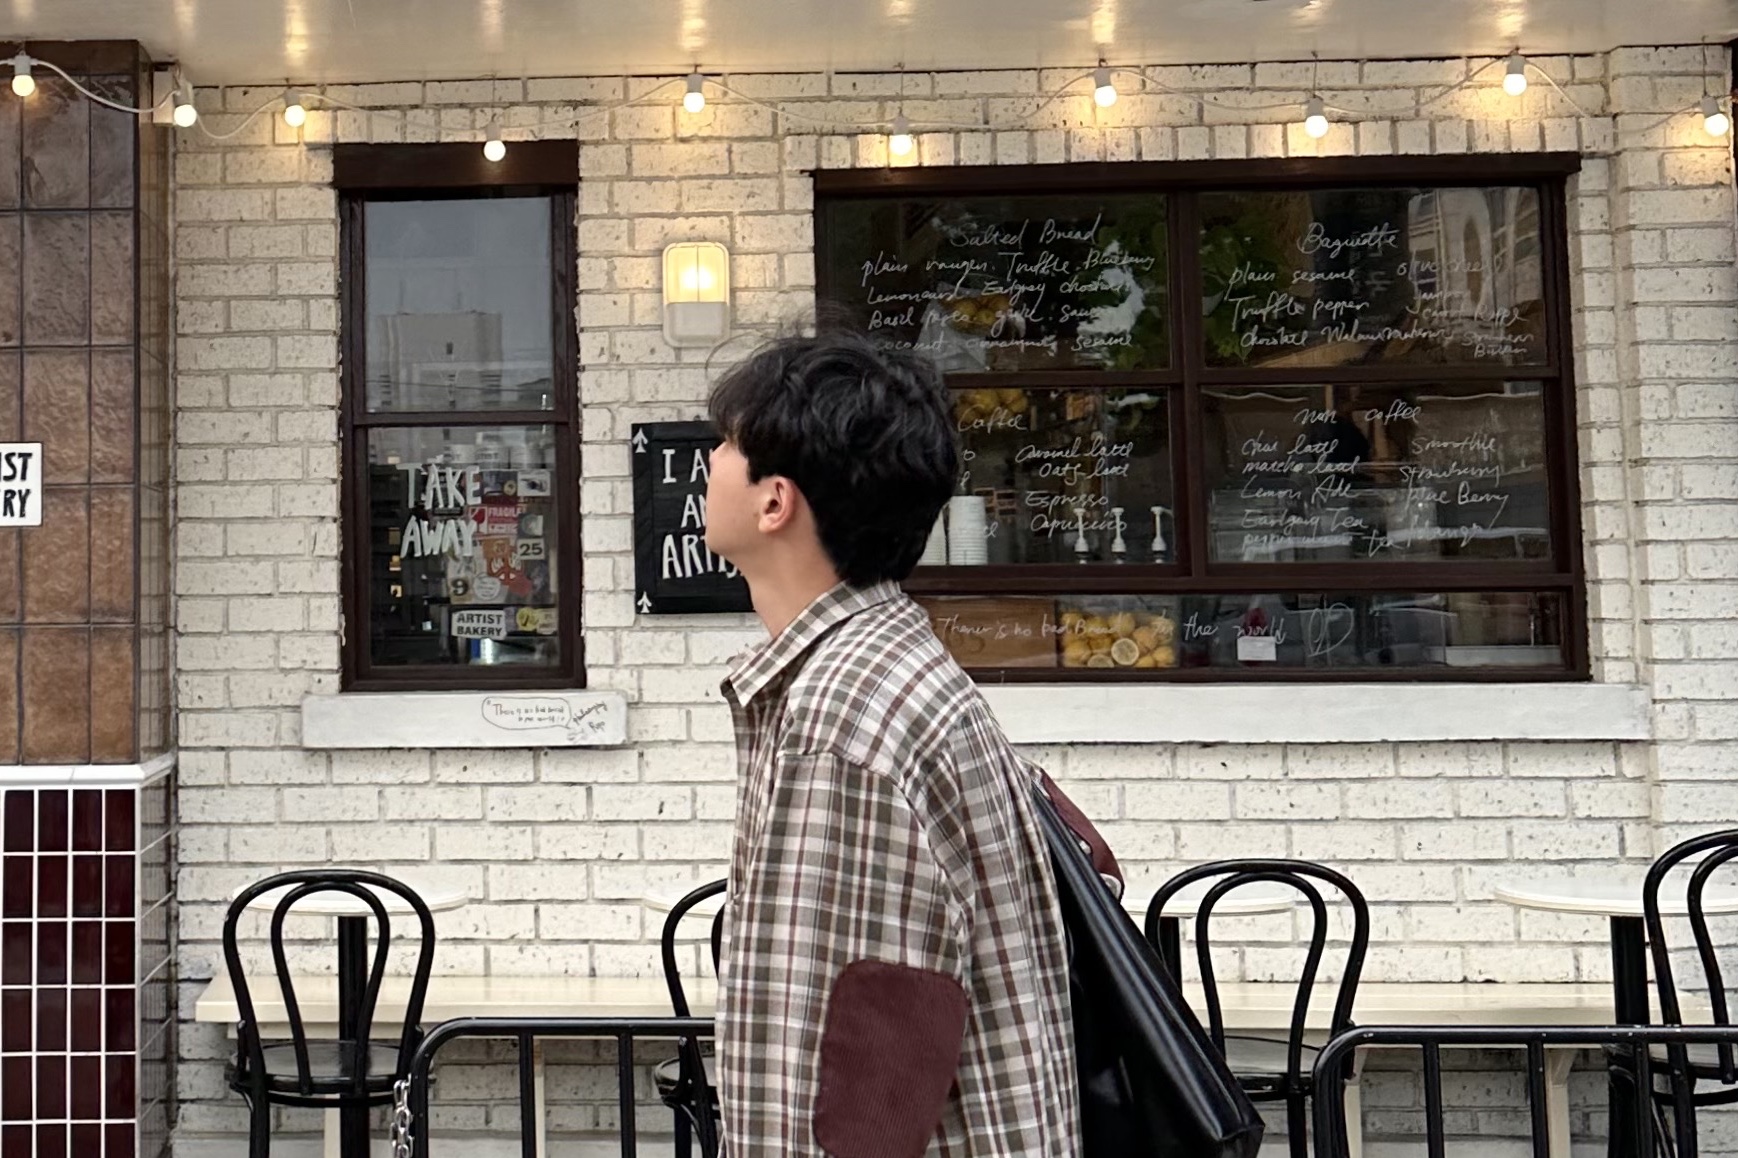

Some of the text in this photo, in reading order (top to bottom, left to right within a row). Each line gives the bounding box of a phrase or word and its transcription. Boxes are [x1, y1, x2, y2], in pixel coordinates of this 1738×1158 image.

[1039, 213, 1102, 246] Bread
[1296, 222, 1400, 259] Baguette
[1224, 260, 1357, 302] plain sesame
[1312, 298, 1371, 321] pepper
[0, 452, 33, 482] ST
[662, 448, 714, 483] I A
[396, 462, 482, 510] TAKE
[0, 488, 31, 518] RY
[1025, 489, 1109, 516] Espresso
[400, 515, 478, 559] AWAY
[519, 543, 543, 557] 25
[451, 578, 469, 596] 9
[456, 613, 503, 626] ARTIST
[456, 625, 503, 637] BAKERY
[1183, 611, 1219, 641] the
